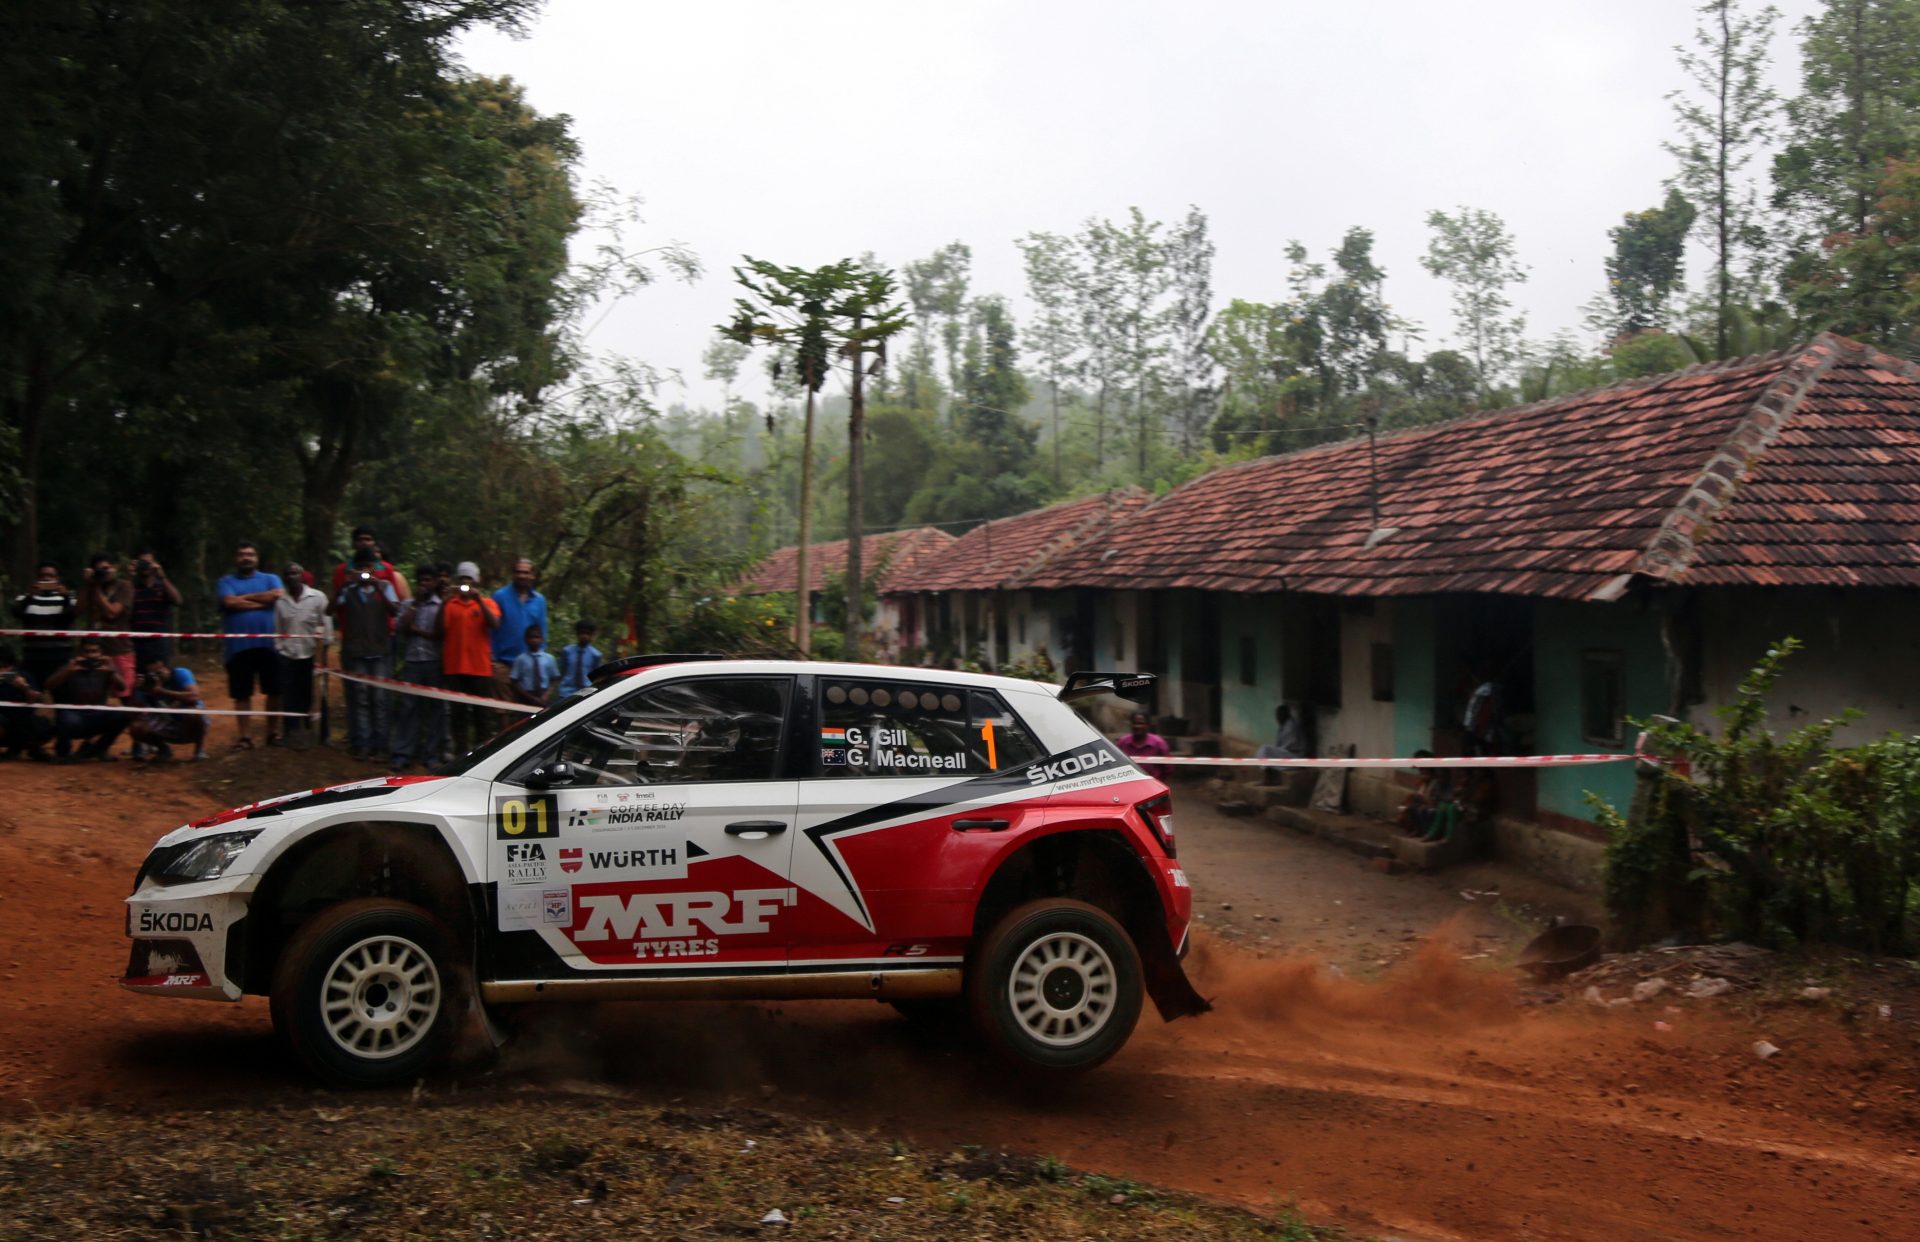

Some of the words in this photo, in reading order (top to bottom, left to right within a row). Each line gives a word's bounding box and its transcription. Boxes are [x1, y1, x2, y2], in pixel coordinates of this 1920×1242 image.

[846, 728, 868, 745] G.
[877, 728, 908, 746] Gill
[981, 719, 997, 770] 1
[847, 749, 869, 766] G.
[877, 750, 967, 769] Macneall
[1026, 749, 1117, 786] ŠKODA
[1056, 769, 1136, 791] www.mrftyres.com
[502, 799, 548, 836] 01
[608, 812, 643, 825] INDIA
[646, 810, 685, 822] RALLY
[610, 803, 658, 814] COFFEE
[662, 802, 686, 811] DAY
[508, 867, 546, 878] RALLY
[140, 909, 214, 932] ŠKODA
[574, 887, 798, 942] MRF
[633, 938, 719, 959] TYRES
[163, 975, 201, 985] MRF
